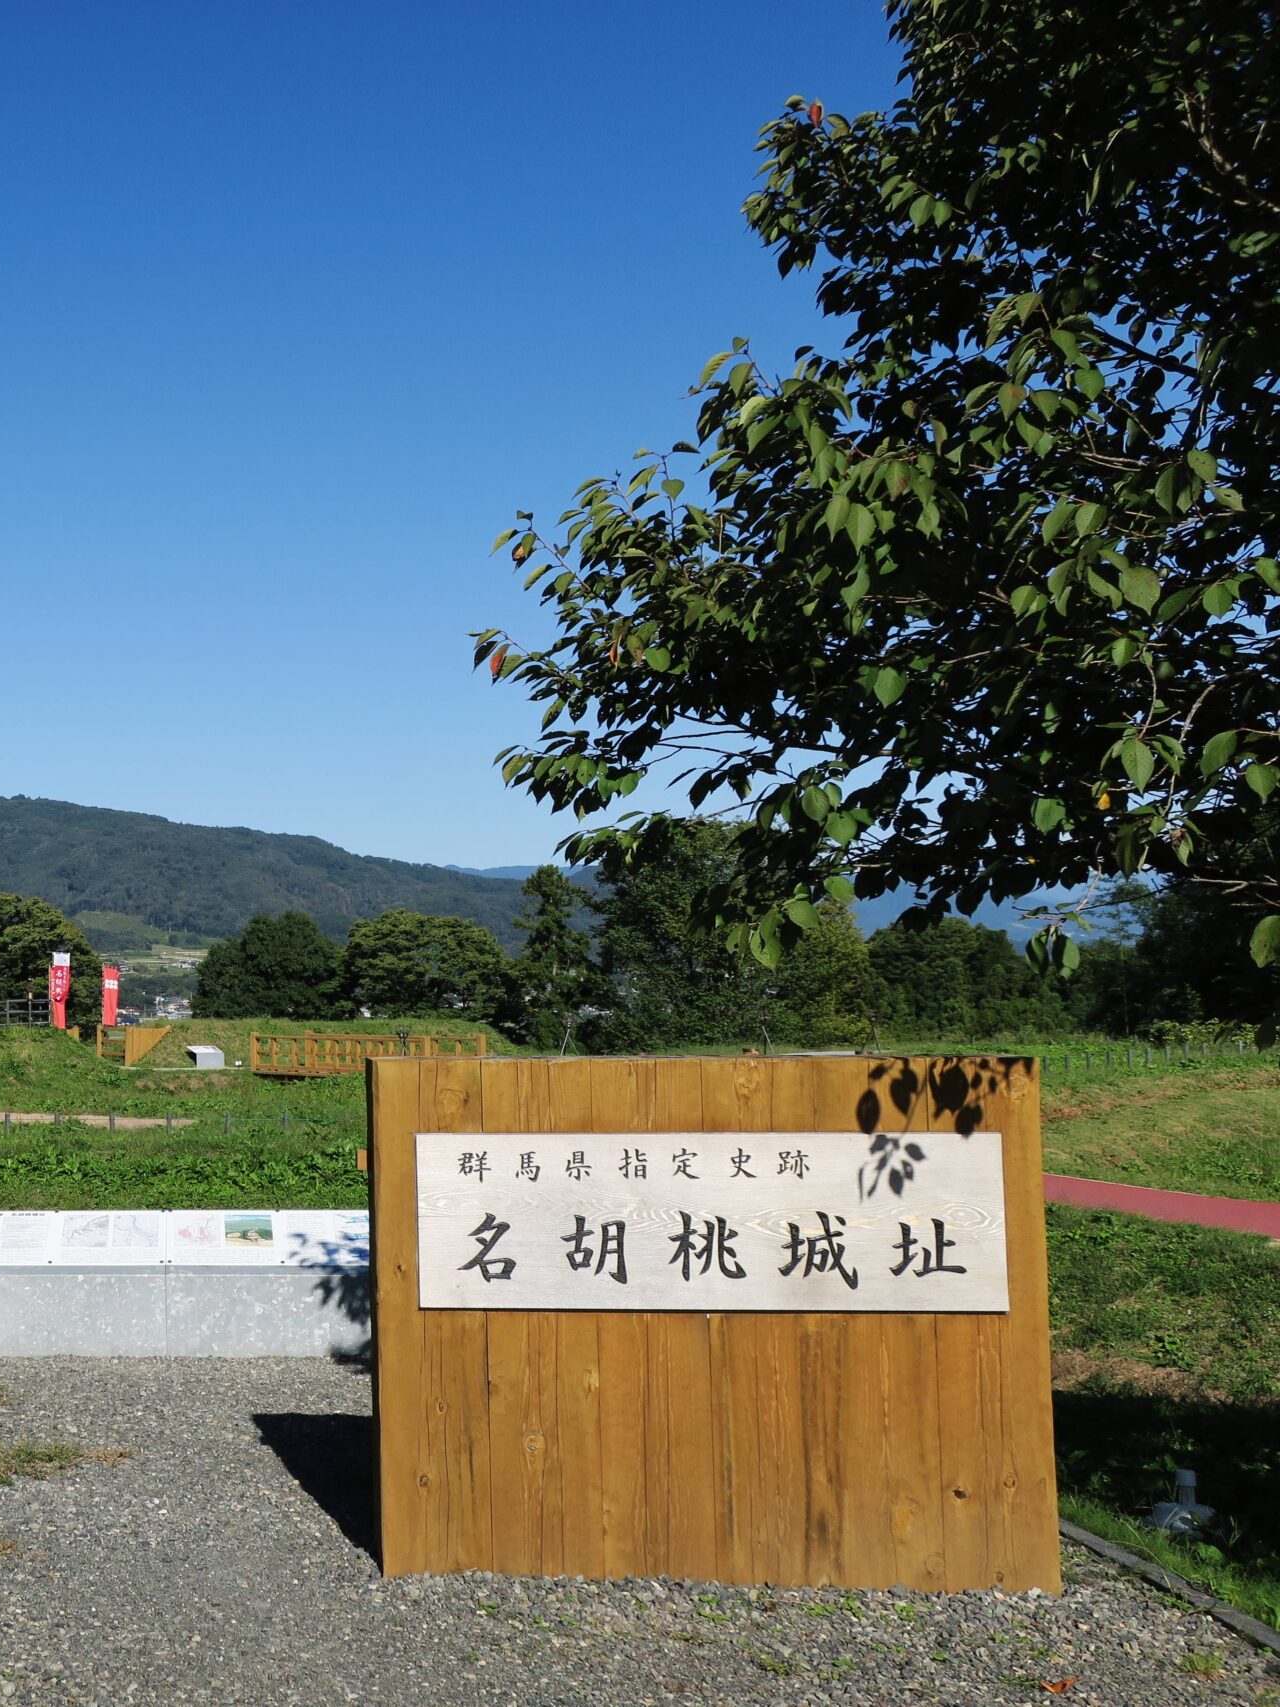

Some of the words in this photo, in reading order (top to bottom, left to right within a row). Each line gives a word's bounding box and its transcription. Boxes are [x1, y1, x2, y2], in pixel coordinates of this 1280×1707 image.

[457, 1148, 810, 1182] 群馬県指定史跡
[457, 1210, 968, 1290] 名胡桃城址
